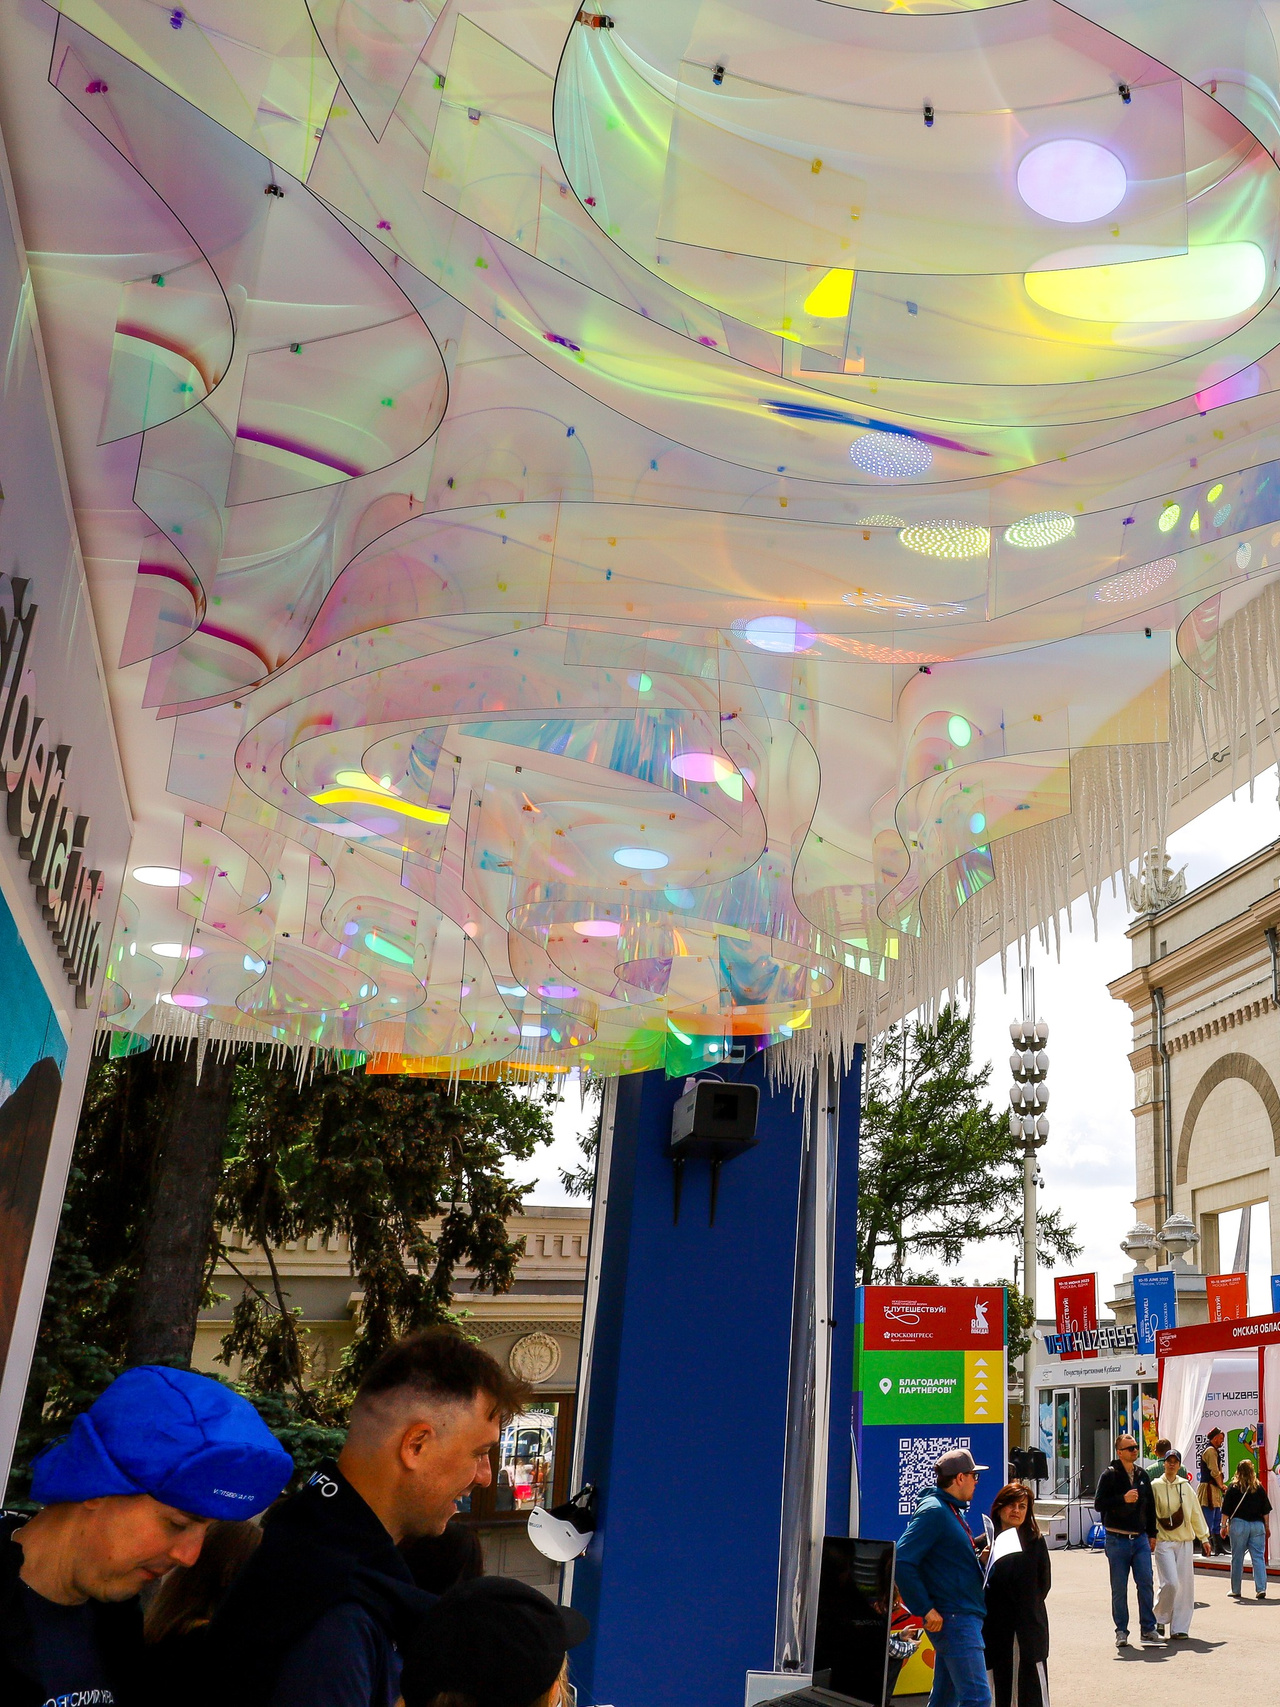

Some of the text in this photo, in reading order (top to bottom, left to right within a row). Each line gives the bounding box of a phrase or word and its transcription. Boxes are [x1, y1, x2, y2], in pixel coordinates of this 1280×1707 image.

[891, 1305, 947, 1313] ПУТЕШЕСТВУЙ!
[1232, 1324, 1259, 1338] ОМСКАЯ
[1044, 1333, 1074, 1355] VISIT
[1072, 1324, 1138, 1352] KUZBASS
[899, 1378, 957, 1386] БЛАГОДАРИМ
[1222, 1391, 1258, 1400] KUZBAS
[1220, 1408, 1258, 1417] ПОЖАЛОВ
